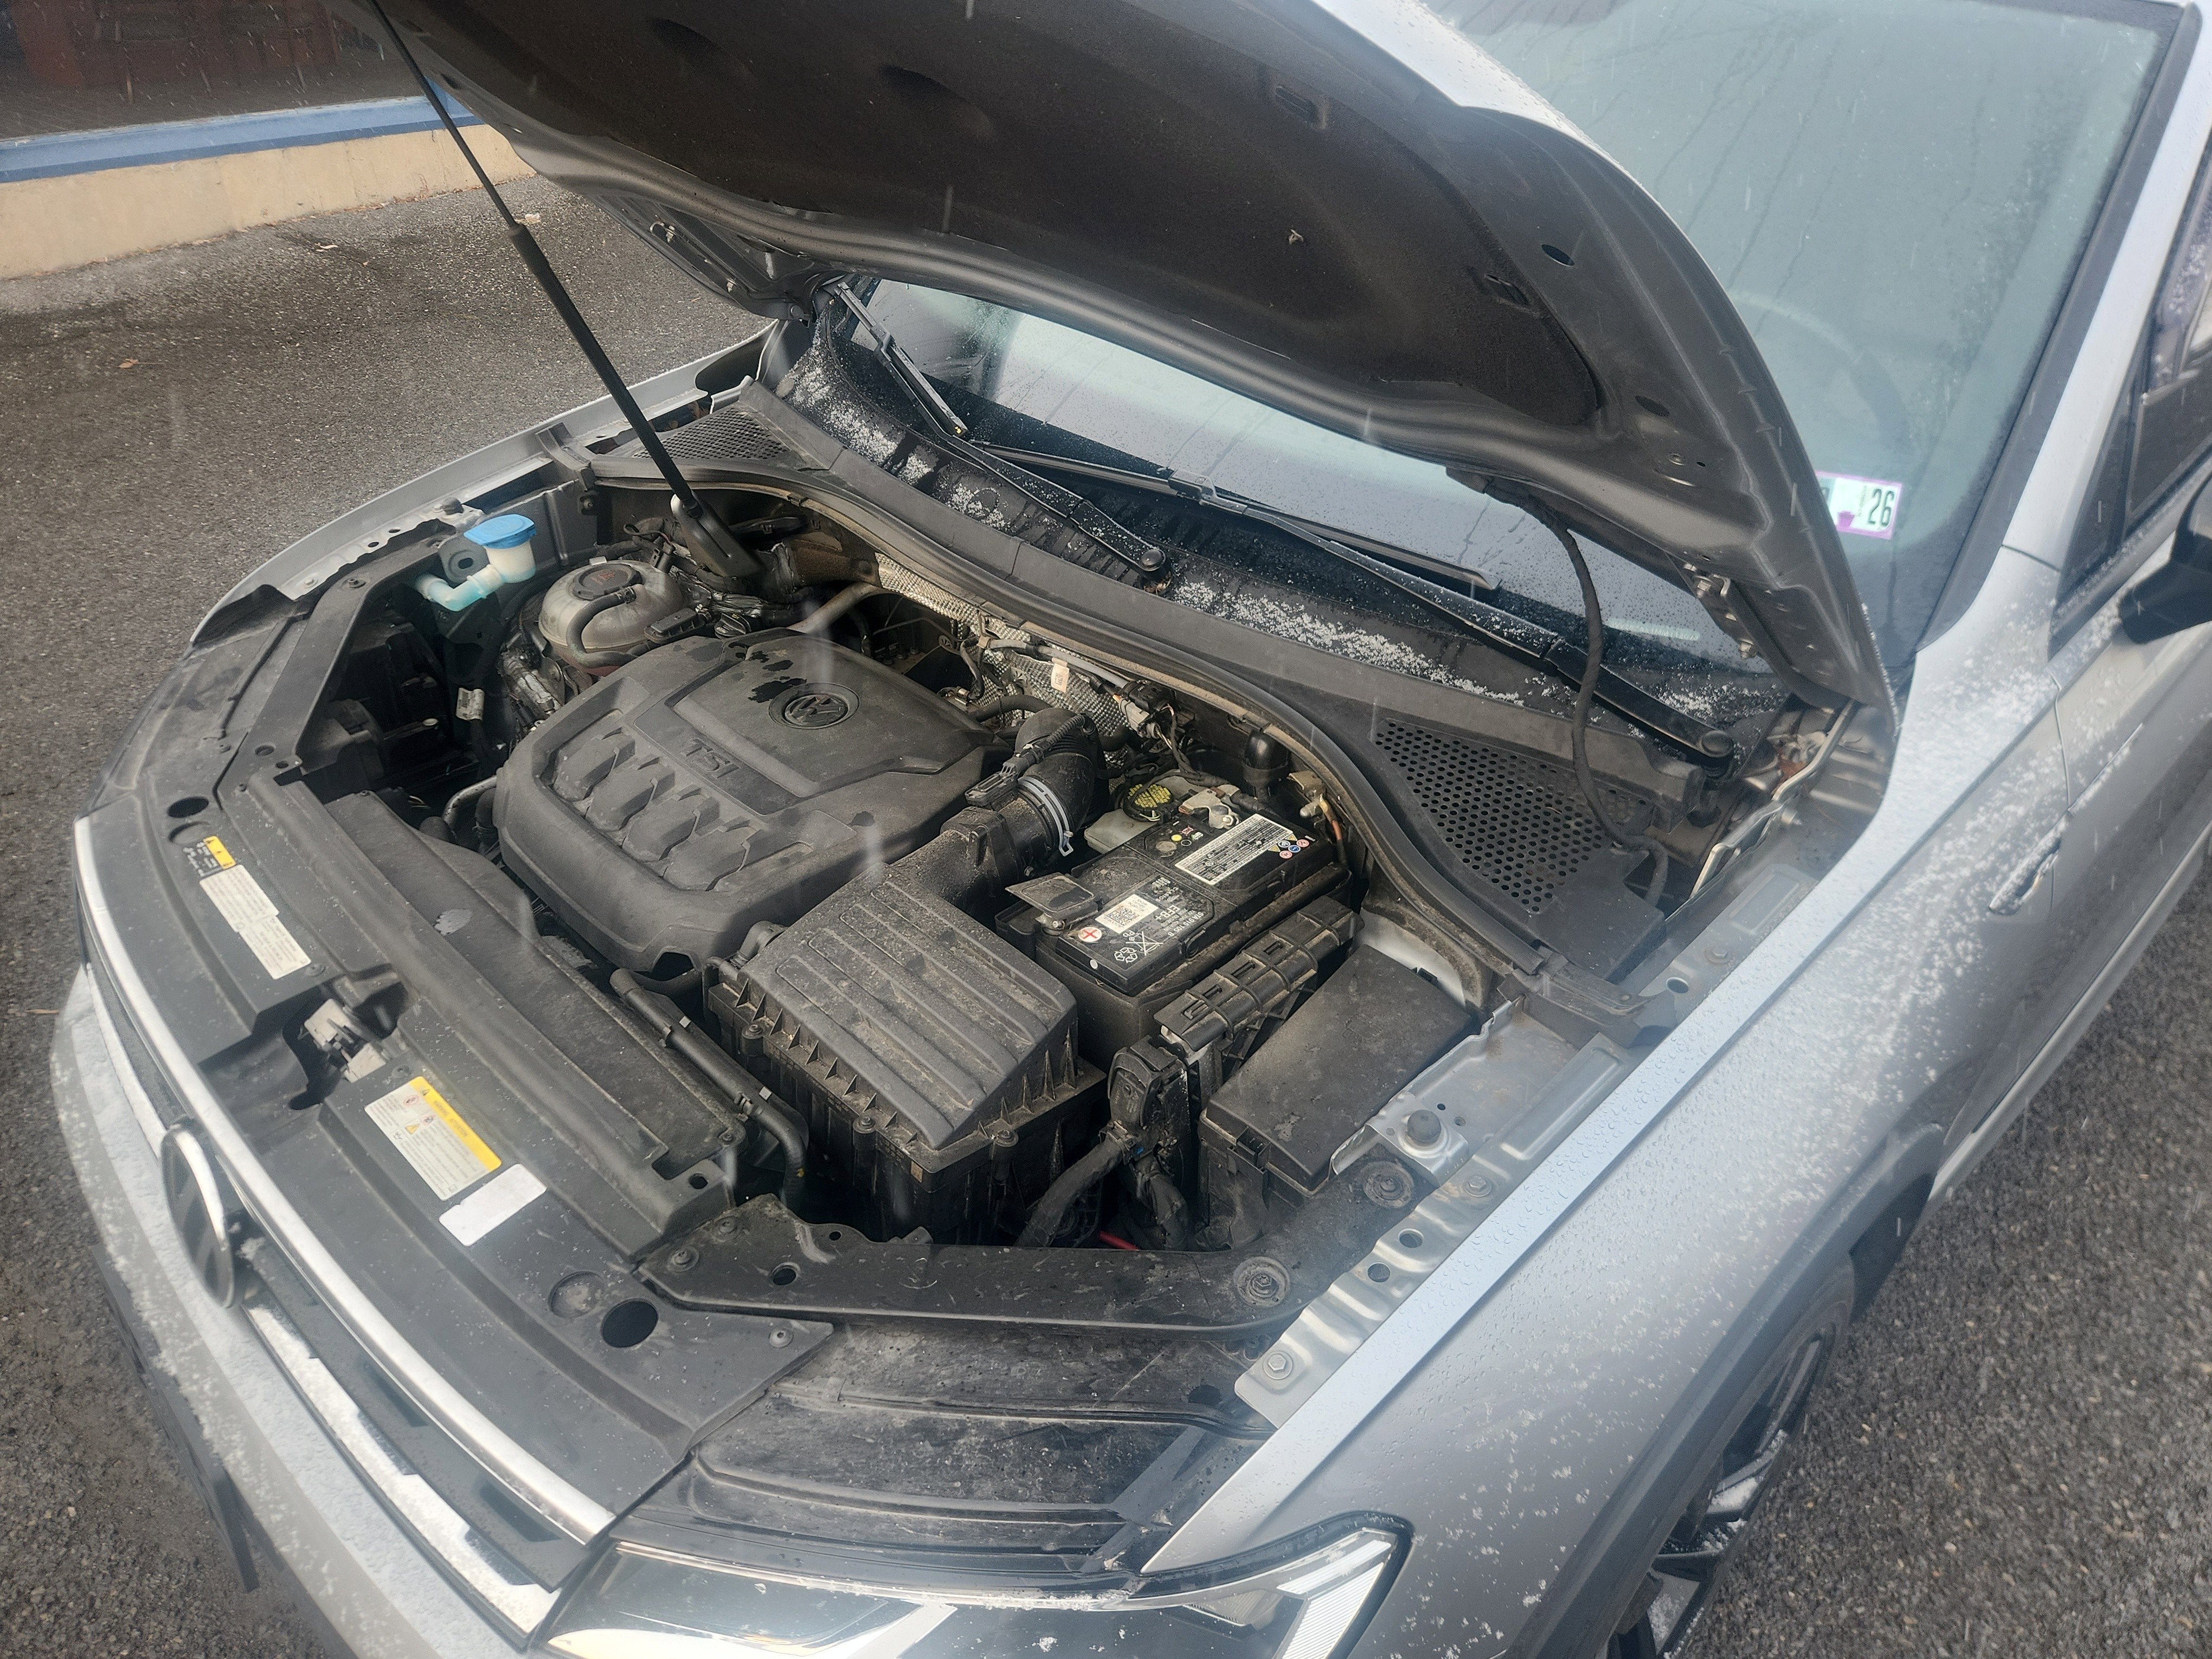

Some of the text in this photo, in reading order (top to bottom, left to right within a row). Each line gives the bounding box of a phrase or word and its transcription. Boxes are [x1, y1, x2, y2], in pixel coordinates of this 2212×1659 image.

[1867, 488, 1894, 526] 26
[680, 737, 741, 779] TSI
[1155, 905, 1180, 920] EFB+
[1193, 911, 1204, 919] 5TA
[1183, 917, 1194, 926] 915
[1174, 923, 1185, 933] 105
